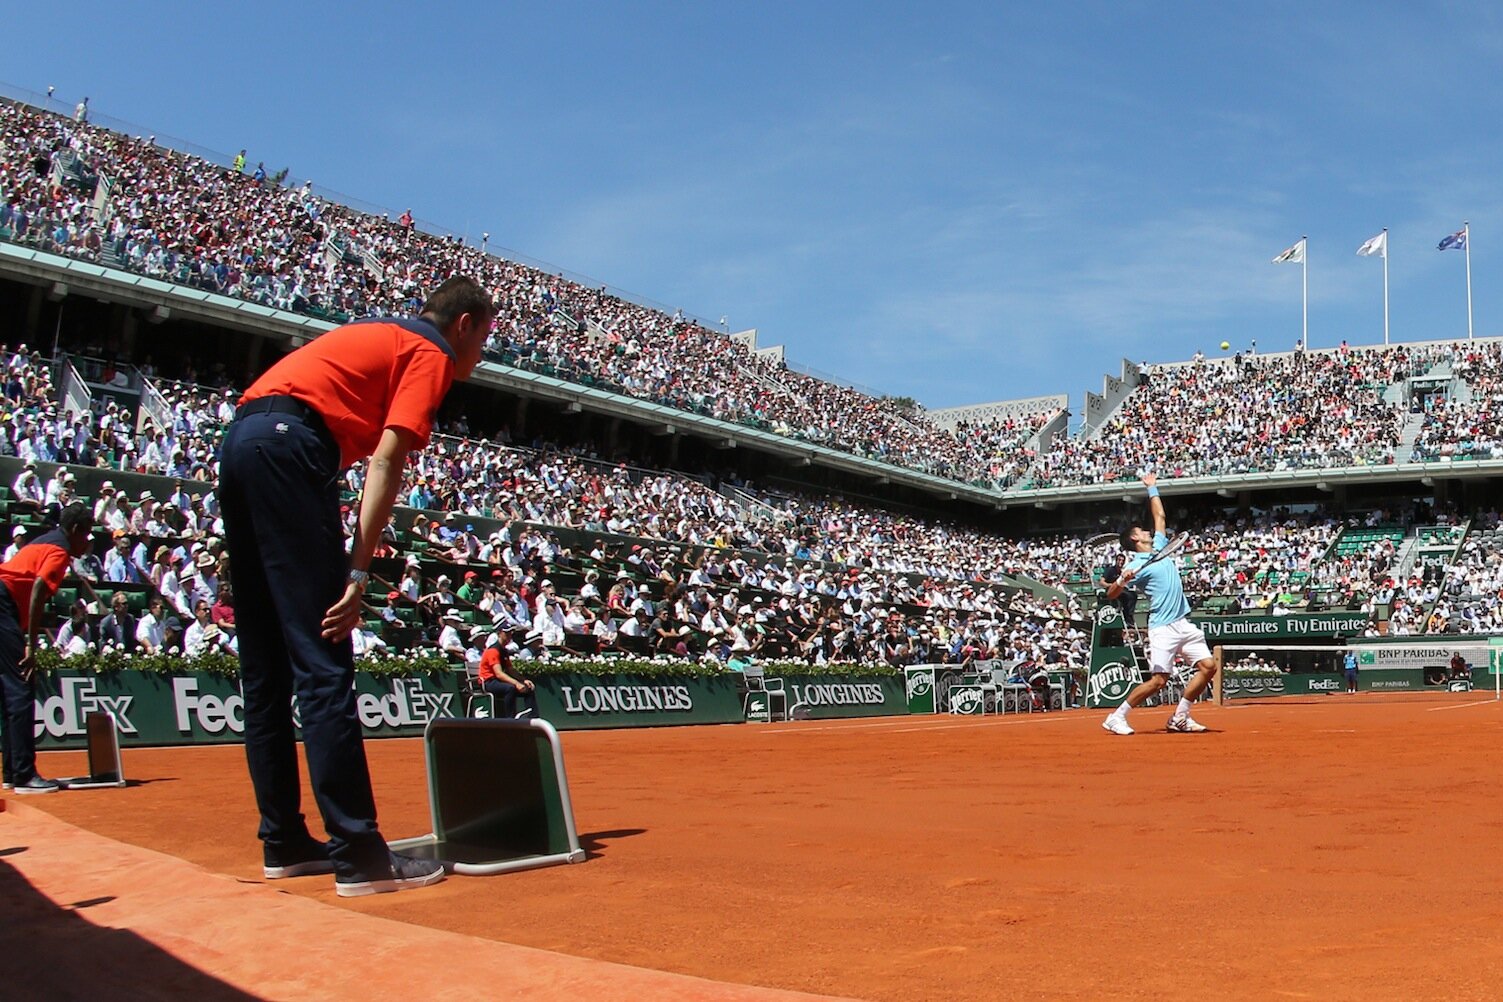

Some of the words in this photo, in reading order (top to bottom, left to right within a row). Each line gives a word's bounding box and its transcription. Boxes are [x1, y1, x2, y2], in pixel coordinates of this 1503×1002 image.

[1200, 621, 1221, 637] Fly
[1223, 620, 1278, 634] Emirates
[1287, 619, 1308, 634] Fly
[1310, 617, 1366, 632] Emirates
[1378, 649, 1400, 659] BNP
[1404, 649, 1449, 658] PARIBAS
[790, 683, 884, 706] LONGINES
[1309, 679, 1340, 690] FedEx
[34, 677, 138, 737] edEx
[352, 678, 455, 728] edEx
[561, 686, 692, 712] LONGINES
